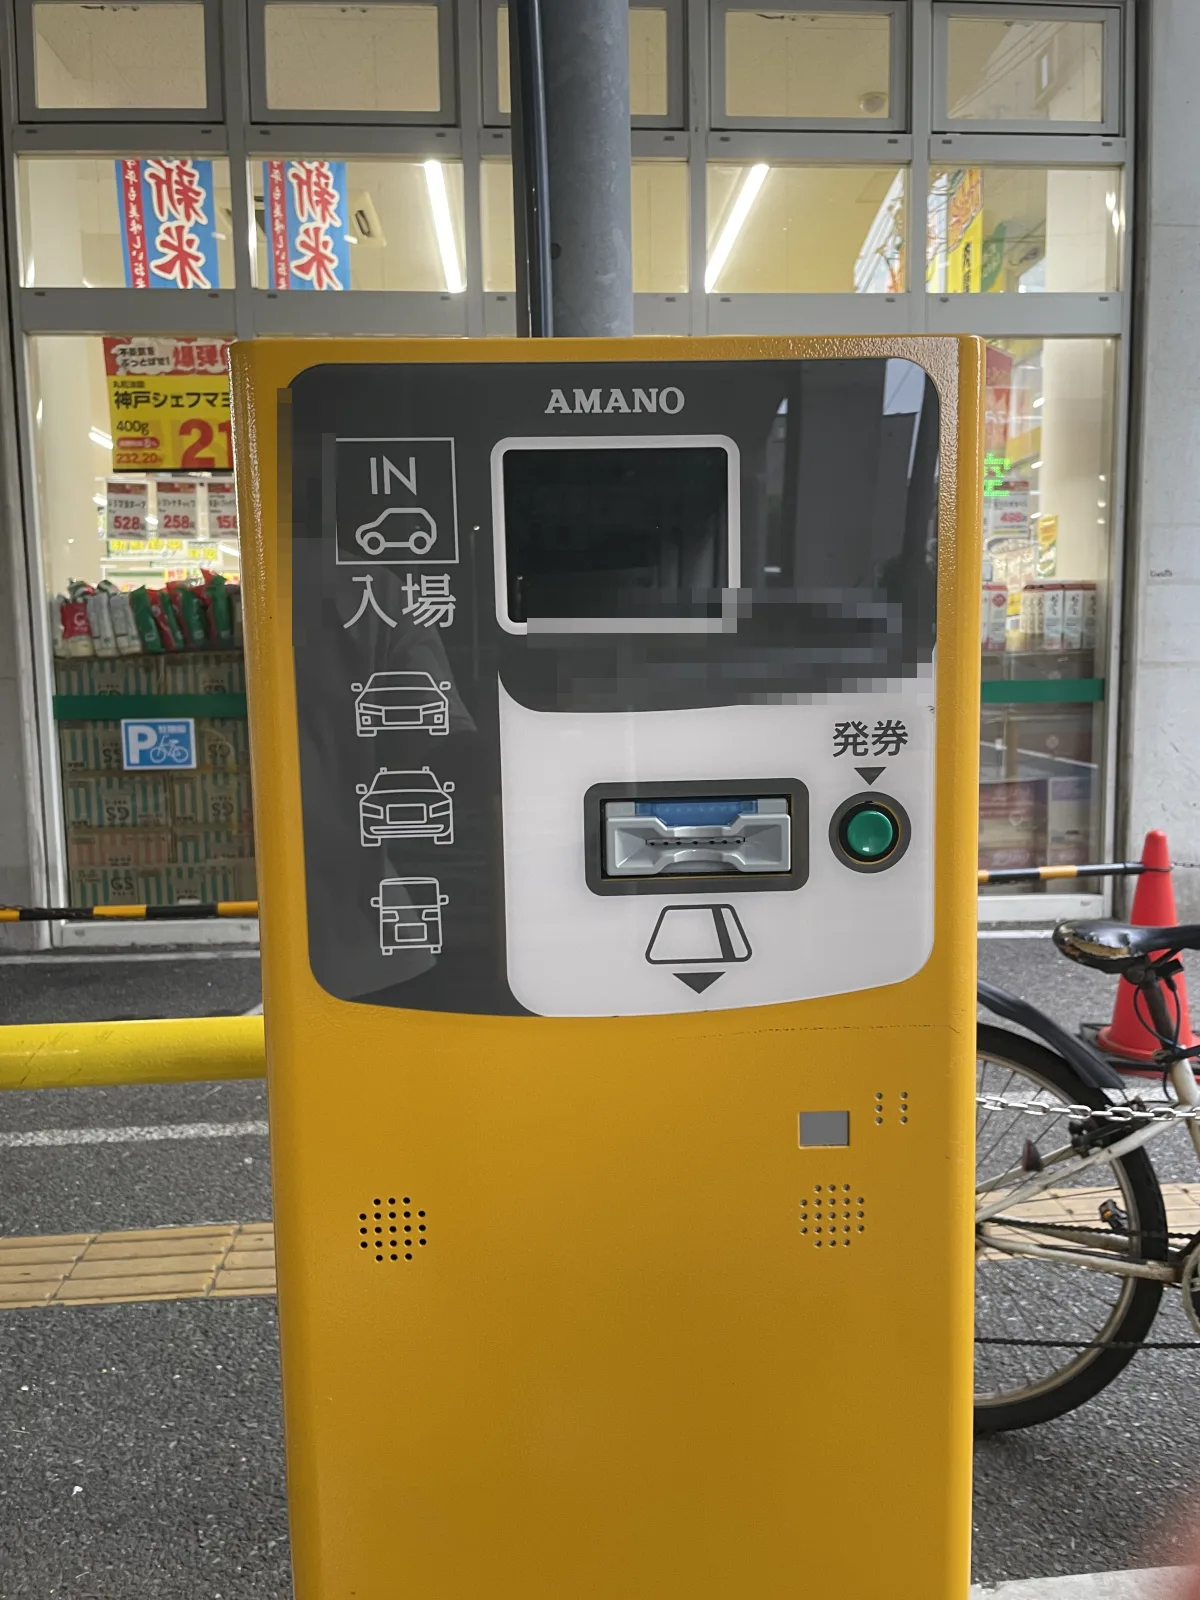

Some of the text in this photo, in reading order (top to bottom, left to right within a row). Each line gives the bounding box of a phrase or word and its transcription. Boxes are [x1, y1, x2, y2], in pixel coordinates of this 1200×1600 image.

[544, 387, 685, 415] AMANO
[116, 420, 149, 436] 400g
[369, 454, 418, 496] IN
[343, 573, 457, 629] 入場
[128, 725, 158, 764] P
[832, 719, 909, 758] 発券
